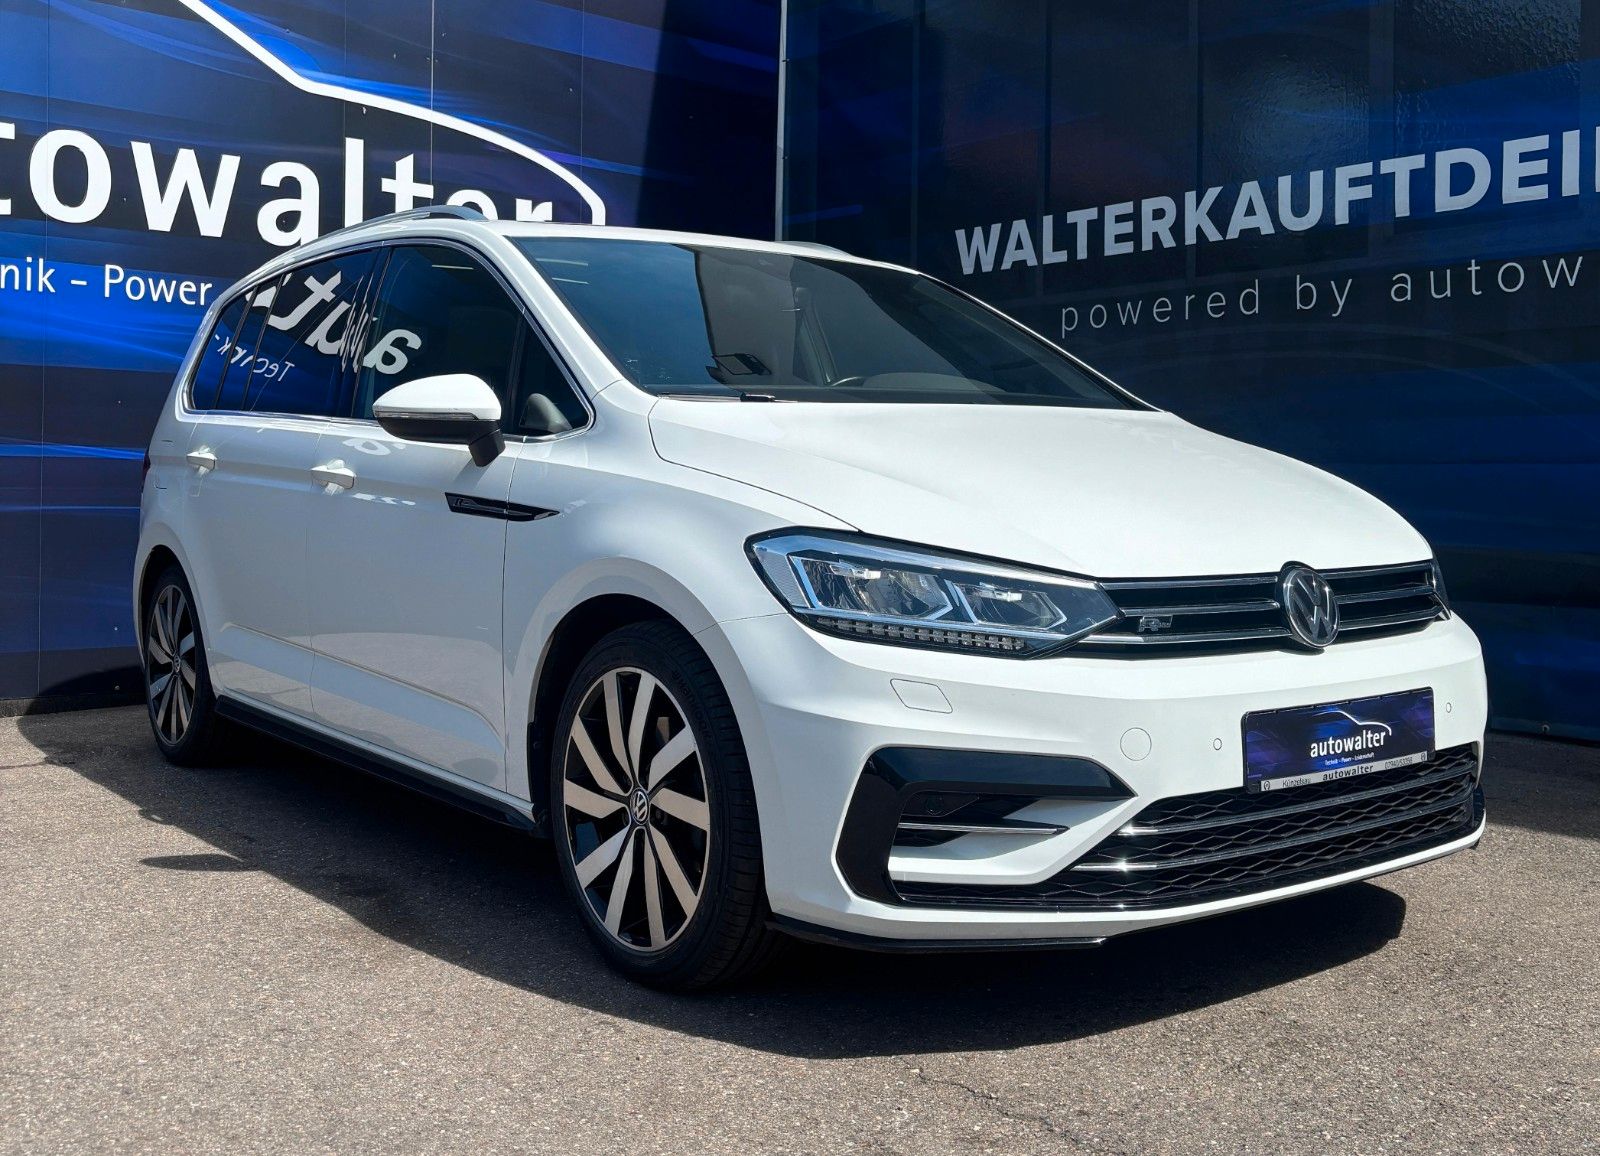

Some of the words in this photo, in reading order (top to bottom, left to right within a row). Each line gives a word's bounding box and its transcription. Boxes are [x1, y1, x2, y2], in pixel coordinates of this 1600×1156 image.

[954, 126, 1600, 275] WALTERKAUFTDEI
[104, 263, 213, 306] Power
[1061, 278, 1260, 339] powered
[1294, 274, 1352, 316] by
[1389, 255, 1584, 302] autow
[1310, 730, 1386, 757] autowalter
[1323, 765, 1374, 781] autowalter
